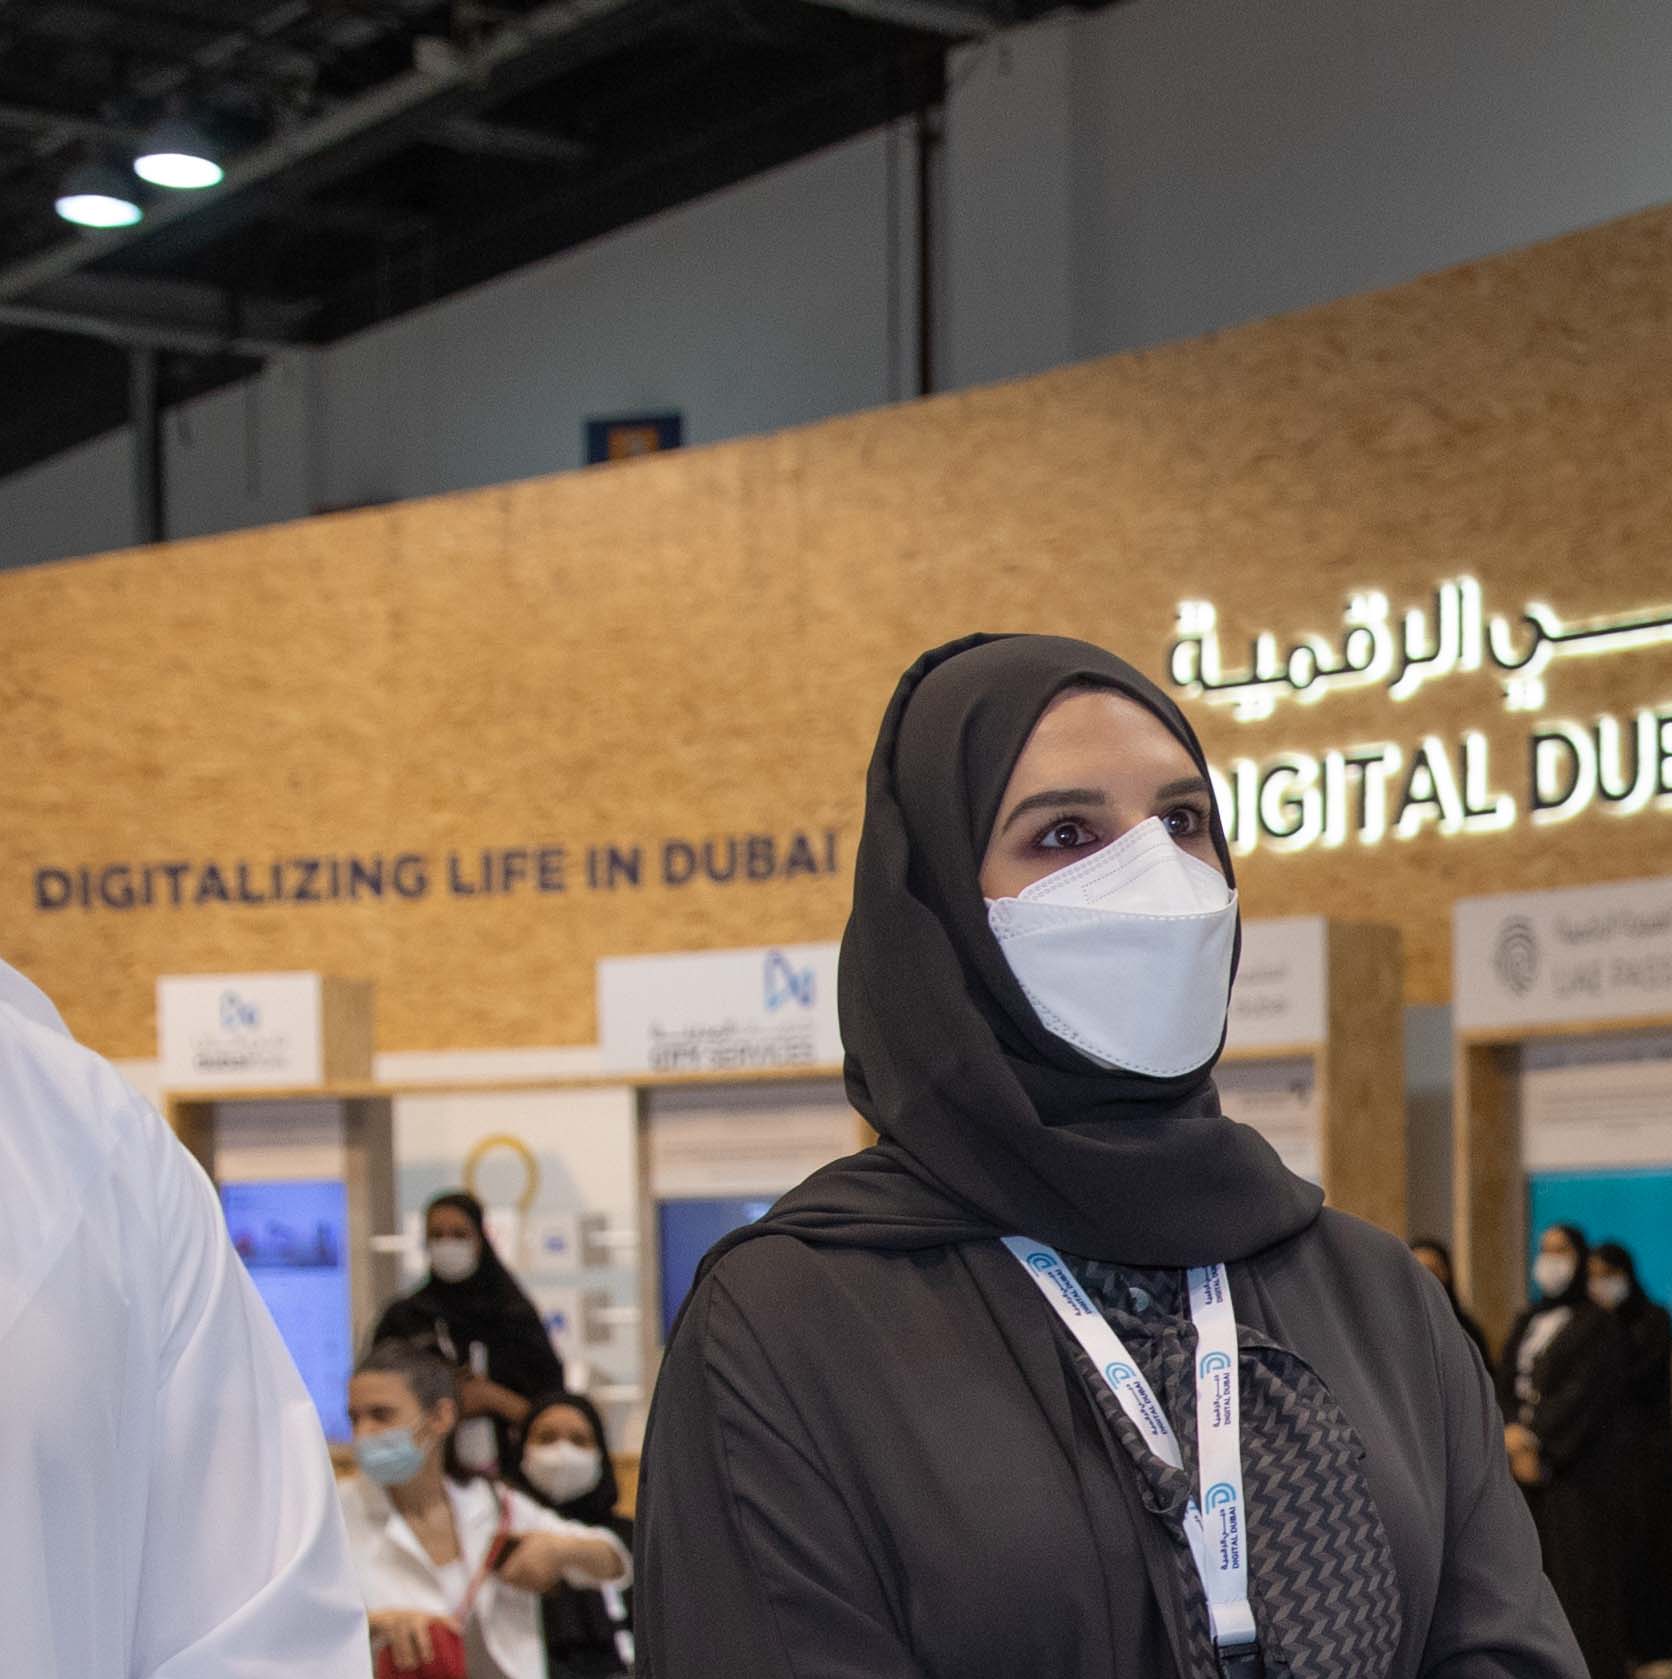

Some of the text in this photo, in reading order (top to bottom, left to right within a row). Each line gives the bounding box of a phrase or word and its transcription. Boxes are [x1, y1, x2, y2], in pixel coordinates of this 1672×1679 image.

[1170, 575, 1481, 722] الرقمية
[34, 829, 840, 912] DIGITALIZING LIFE IN DUBAI
[1134, 1381, 1168, 1435] DIGITAL DUBAI
[1223, 1372, 1231, 1395] DUBAI
[1228, 1506, 1240, 1569] DIGITAL DUBAI
